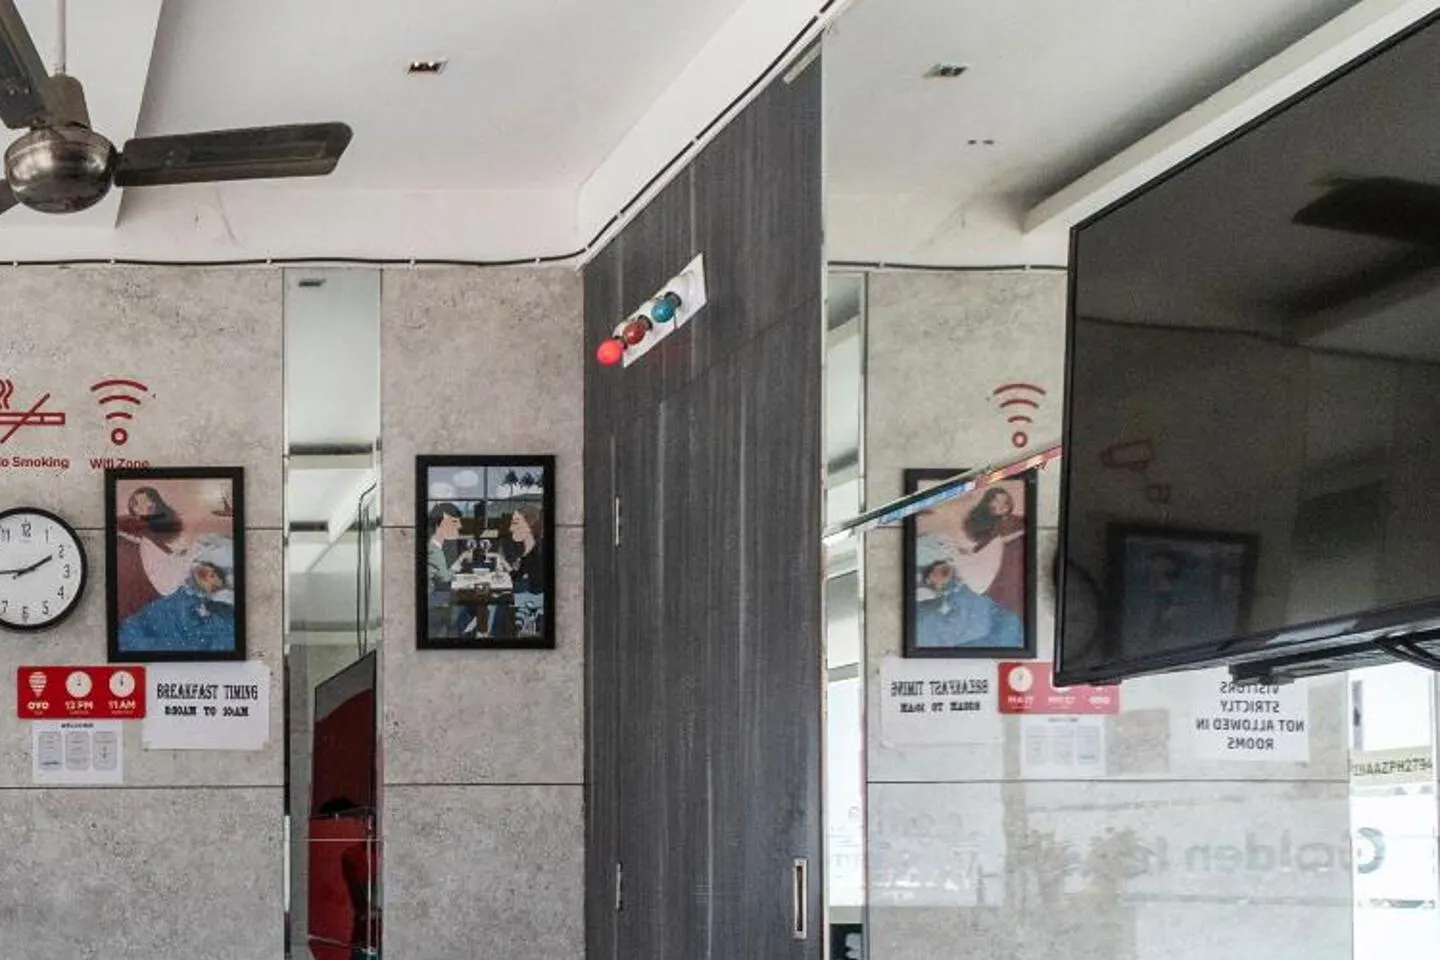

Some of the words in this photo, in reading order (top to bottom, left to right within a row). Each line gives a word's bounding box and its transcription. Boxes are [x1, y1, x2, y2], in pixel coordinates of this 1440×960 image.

[12, 456, 70, 470] Smoking
[116, 458, 150, 470] Zone
[63, 563, 71, 579] 3
[57, 585, 65, 600] 4
[1, 600, 9, 614] 7
[42, 600, 49, 615] 5
[157, 683, 218, 700] BREAKFAST
[223, 684, 258, 701] TIMING
